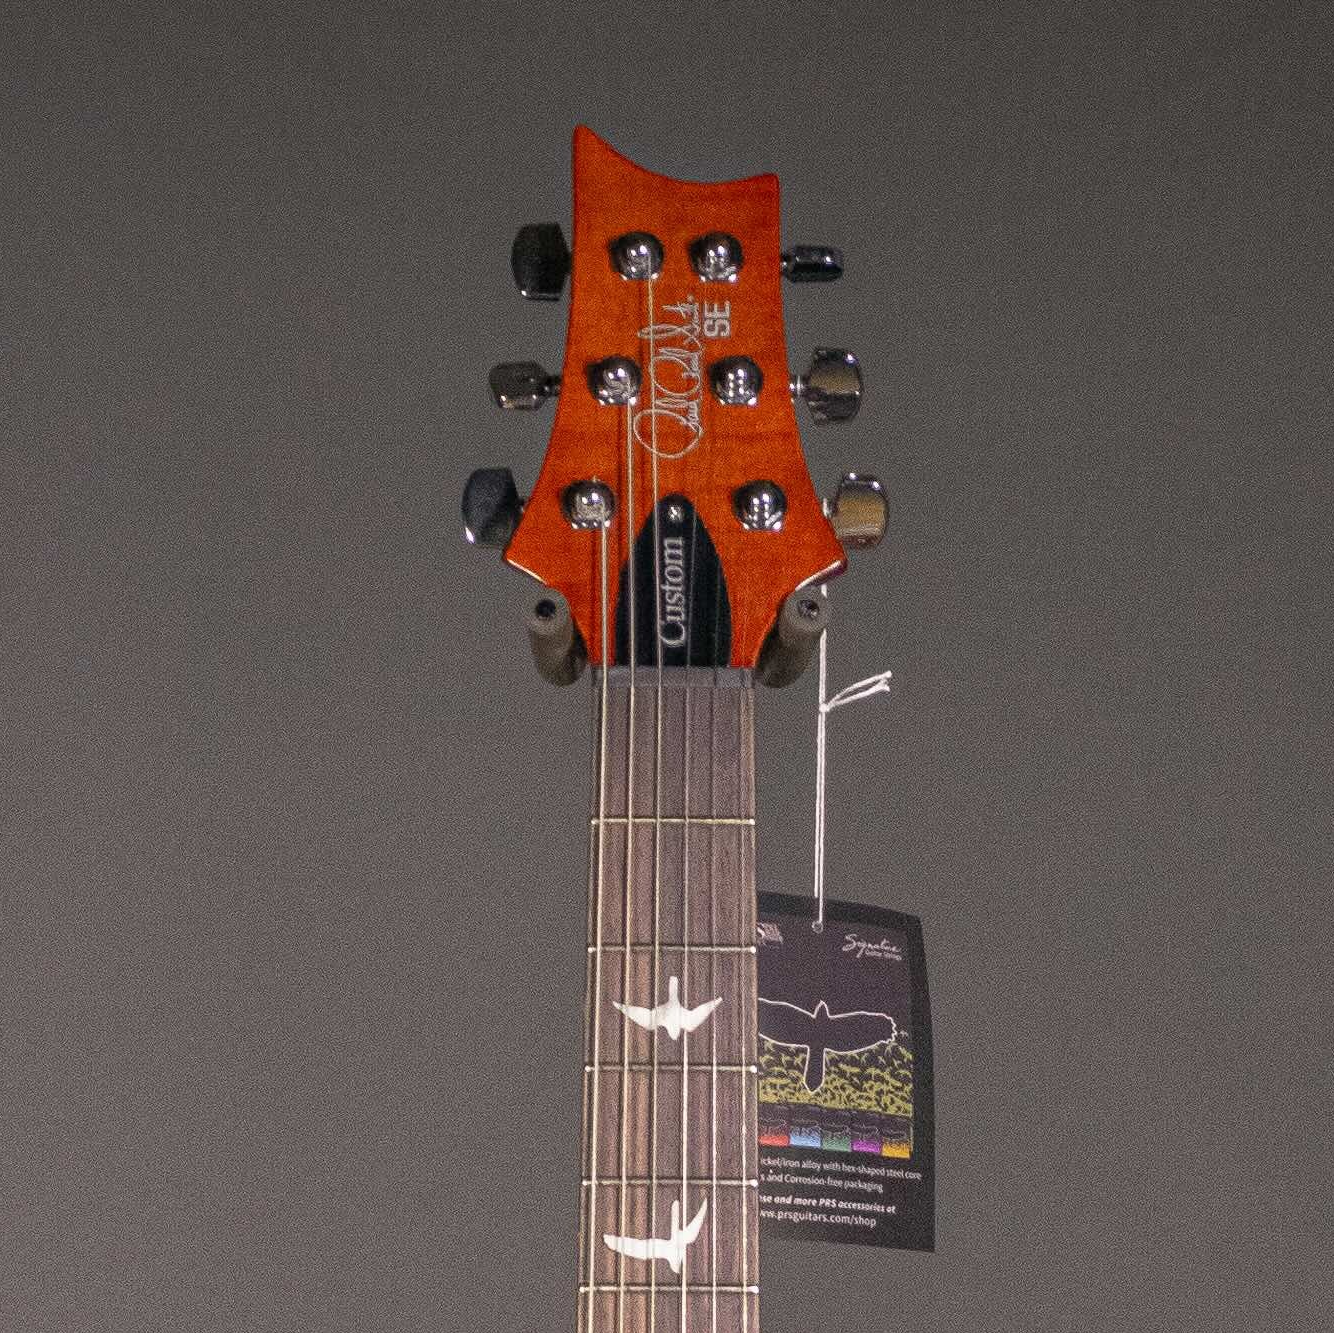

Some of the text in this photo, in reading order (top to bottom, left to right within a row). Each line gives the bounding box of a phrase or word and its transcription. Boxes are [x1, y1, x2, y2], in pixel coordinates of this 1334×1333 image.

[703, 300, 731, 338] SE
[659, 536, 685, 647] Custom
[802, 1161, 821, 1172] alloy
[823, 1162, 840, 1170] with
[842, 1163, 885, 1177] hex-shaped
[886, 1169, 904, 1178] steel
[767, 1173, 783, 1182] and
[784, 1174, 843, 1187] Corrosion-free
[844, 1181, 883, 1193] packaging
[774, 1195, 792, 1204] and
[794, 1198, 817, 1206] more
[819, 1199, 836, 1207] PRS
[838, 1200, 885, 1213] accessories
[887, 1206, 896, 1214] at
